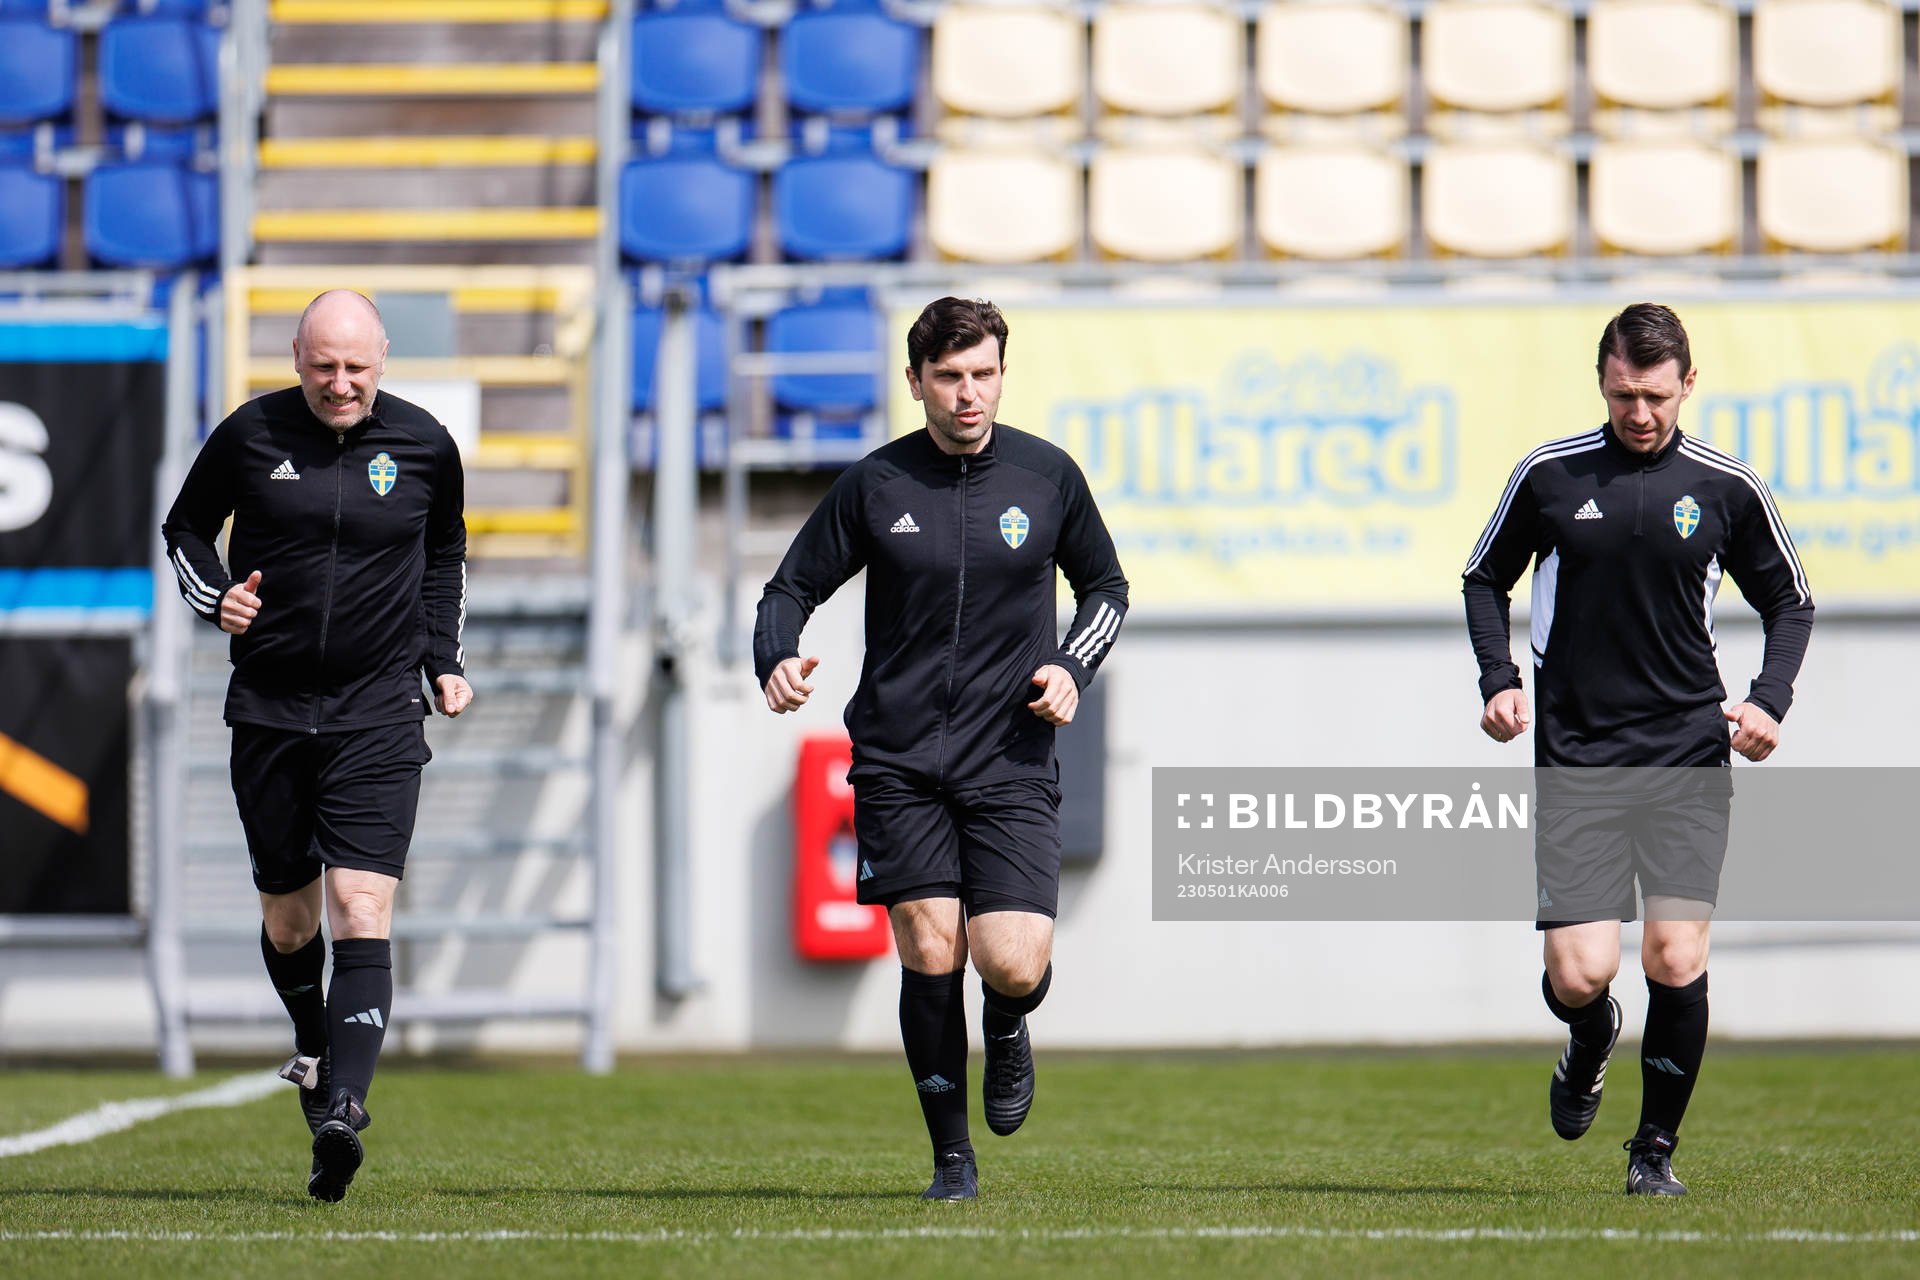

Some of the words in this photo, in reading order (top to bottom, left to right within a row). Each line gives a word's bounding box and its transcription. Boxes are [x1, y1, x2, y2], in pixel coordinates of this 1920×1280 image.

[270, 471, 300, 480] adidas
[1574, 510, 1603, 520] adidas
[890, 524, 920, 533] adidas
